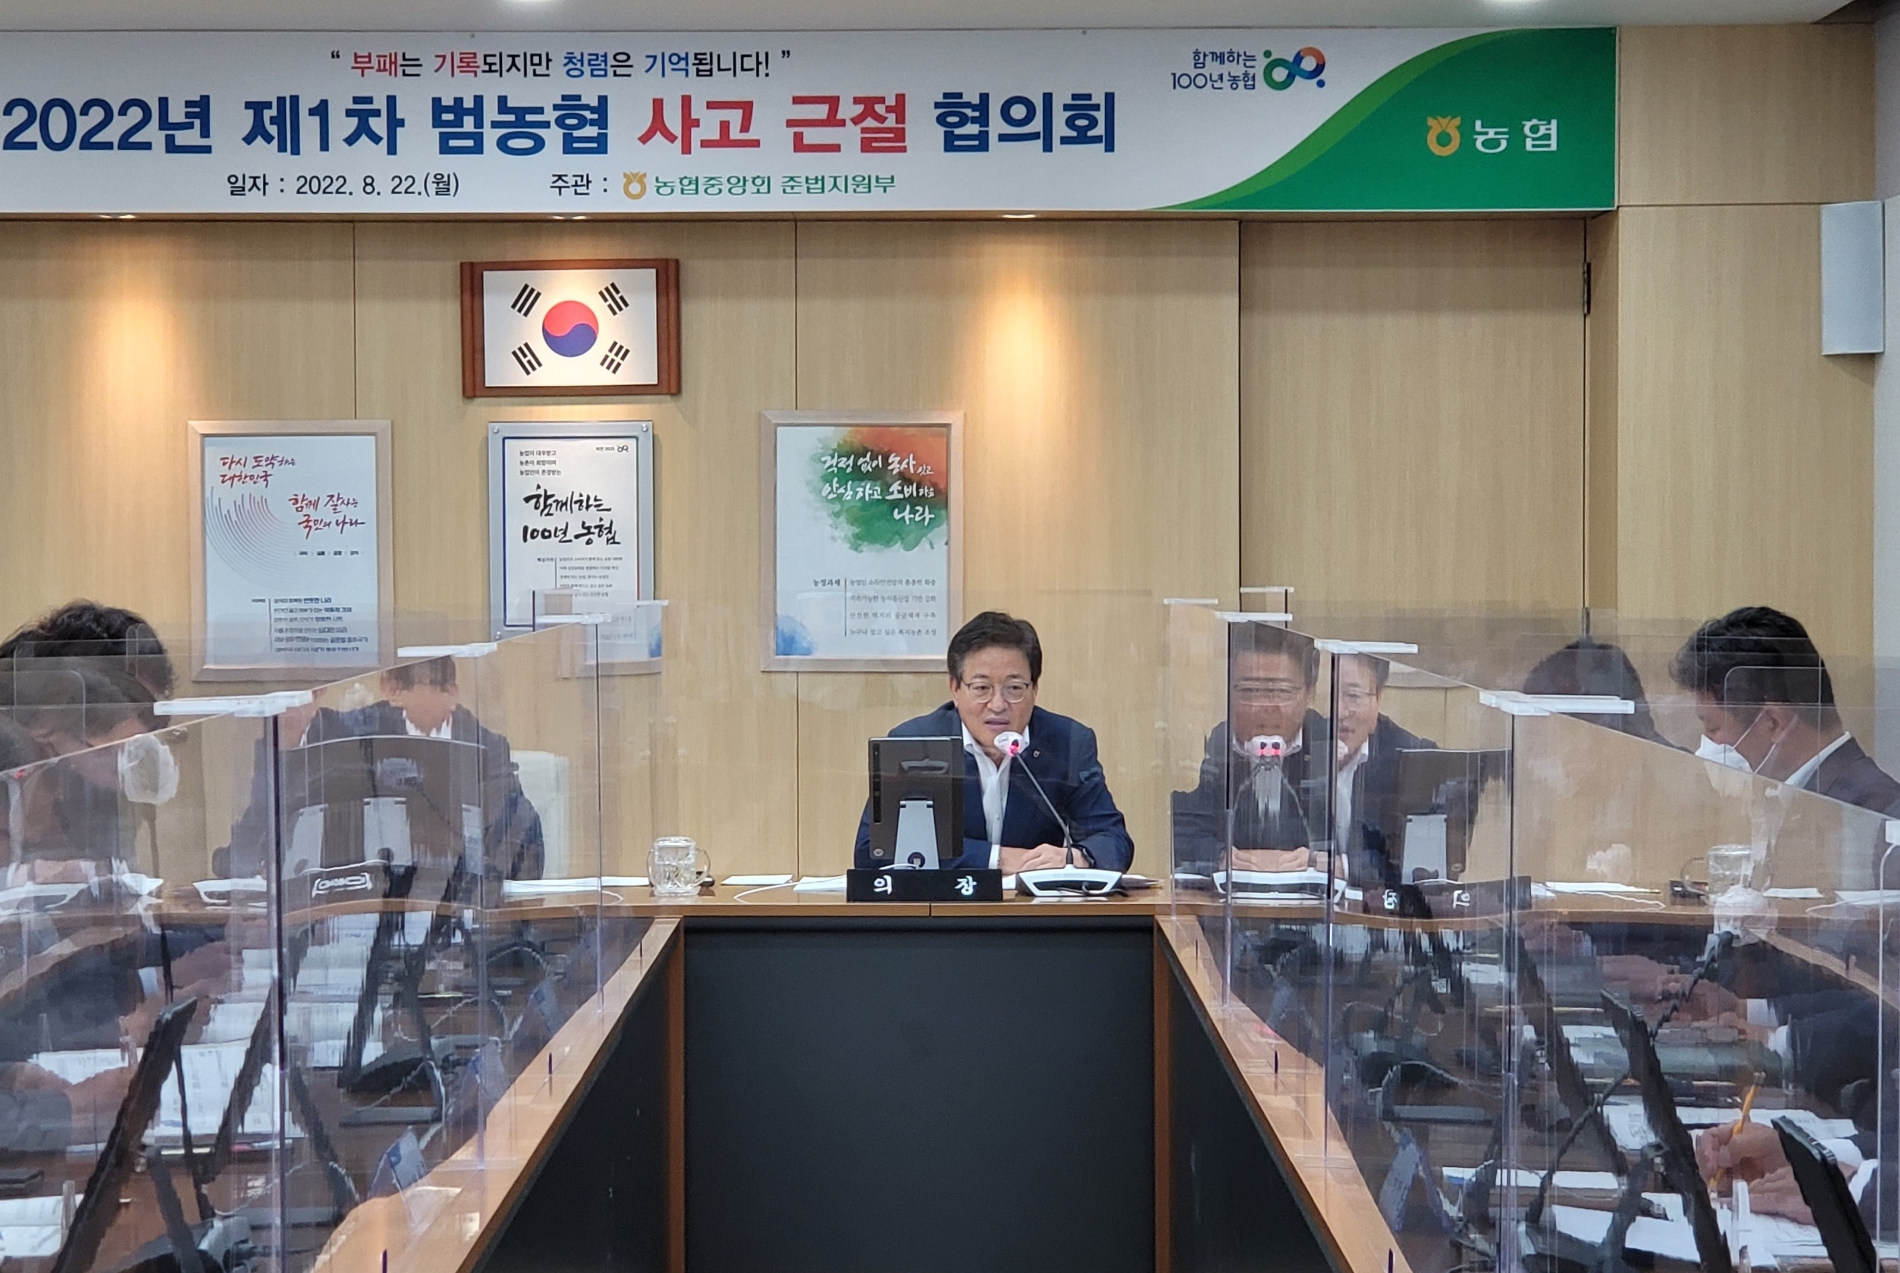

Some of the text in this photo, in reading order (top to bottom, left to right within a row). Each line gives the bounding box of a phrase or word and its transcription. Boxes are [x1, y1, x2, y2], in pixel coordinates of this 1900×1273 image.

[350, 51, 424, 78] 부패는
[434, 51, 553, 78] 기록되지만
[562, 51, 634, 79] 청렴은
[644, 50, 770, 78] 기억됩니다!
[1192, 48, 1258, 70] 함께하는
[1170, 69, 1256, 91] 100년 농협
[2, 91, 1116, 157] 2022년 제1차 범농협 사고 근절 협의회
[1473, 118, 1558, 154] 농협
[226, 173, 270, 197] 일자
[295, 174, 353, 196] 2022.
[362, 174, 381, 196] 8.
[390, 172, 459, 198] 22.(월)
[549, 172, 593, 197] 주관
[654, 174, 771, 197] 농협중앙회
[781, 174, 896, 195] 준법지원부
[220, 453, 297, 470] 다시 도약하는
[820, 452, 854, 474] 걱정
[857, 451, 883, 474] 없이
[887, 452, 917, 475] 농사
[219, 470, 273, 489] 대한민국
[884, 480, 935, 500] 소비하는
[288, 492, 359, 514] 함께 잘사는
[523, 483, 612, 517] 함께하는
[297, 514, 366, 540] 국민의 나라
[893, 504, 935, 526] 나라
[522, 517, 621, 546] 100년 농협
